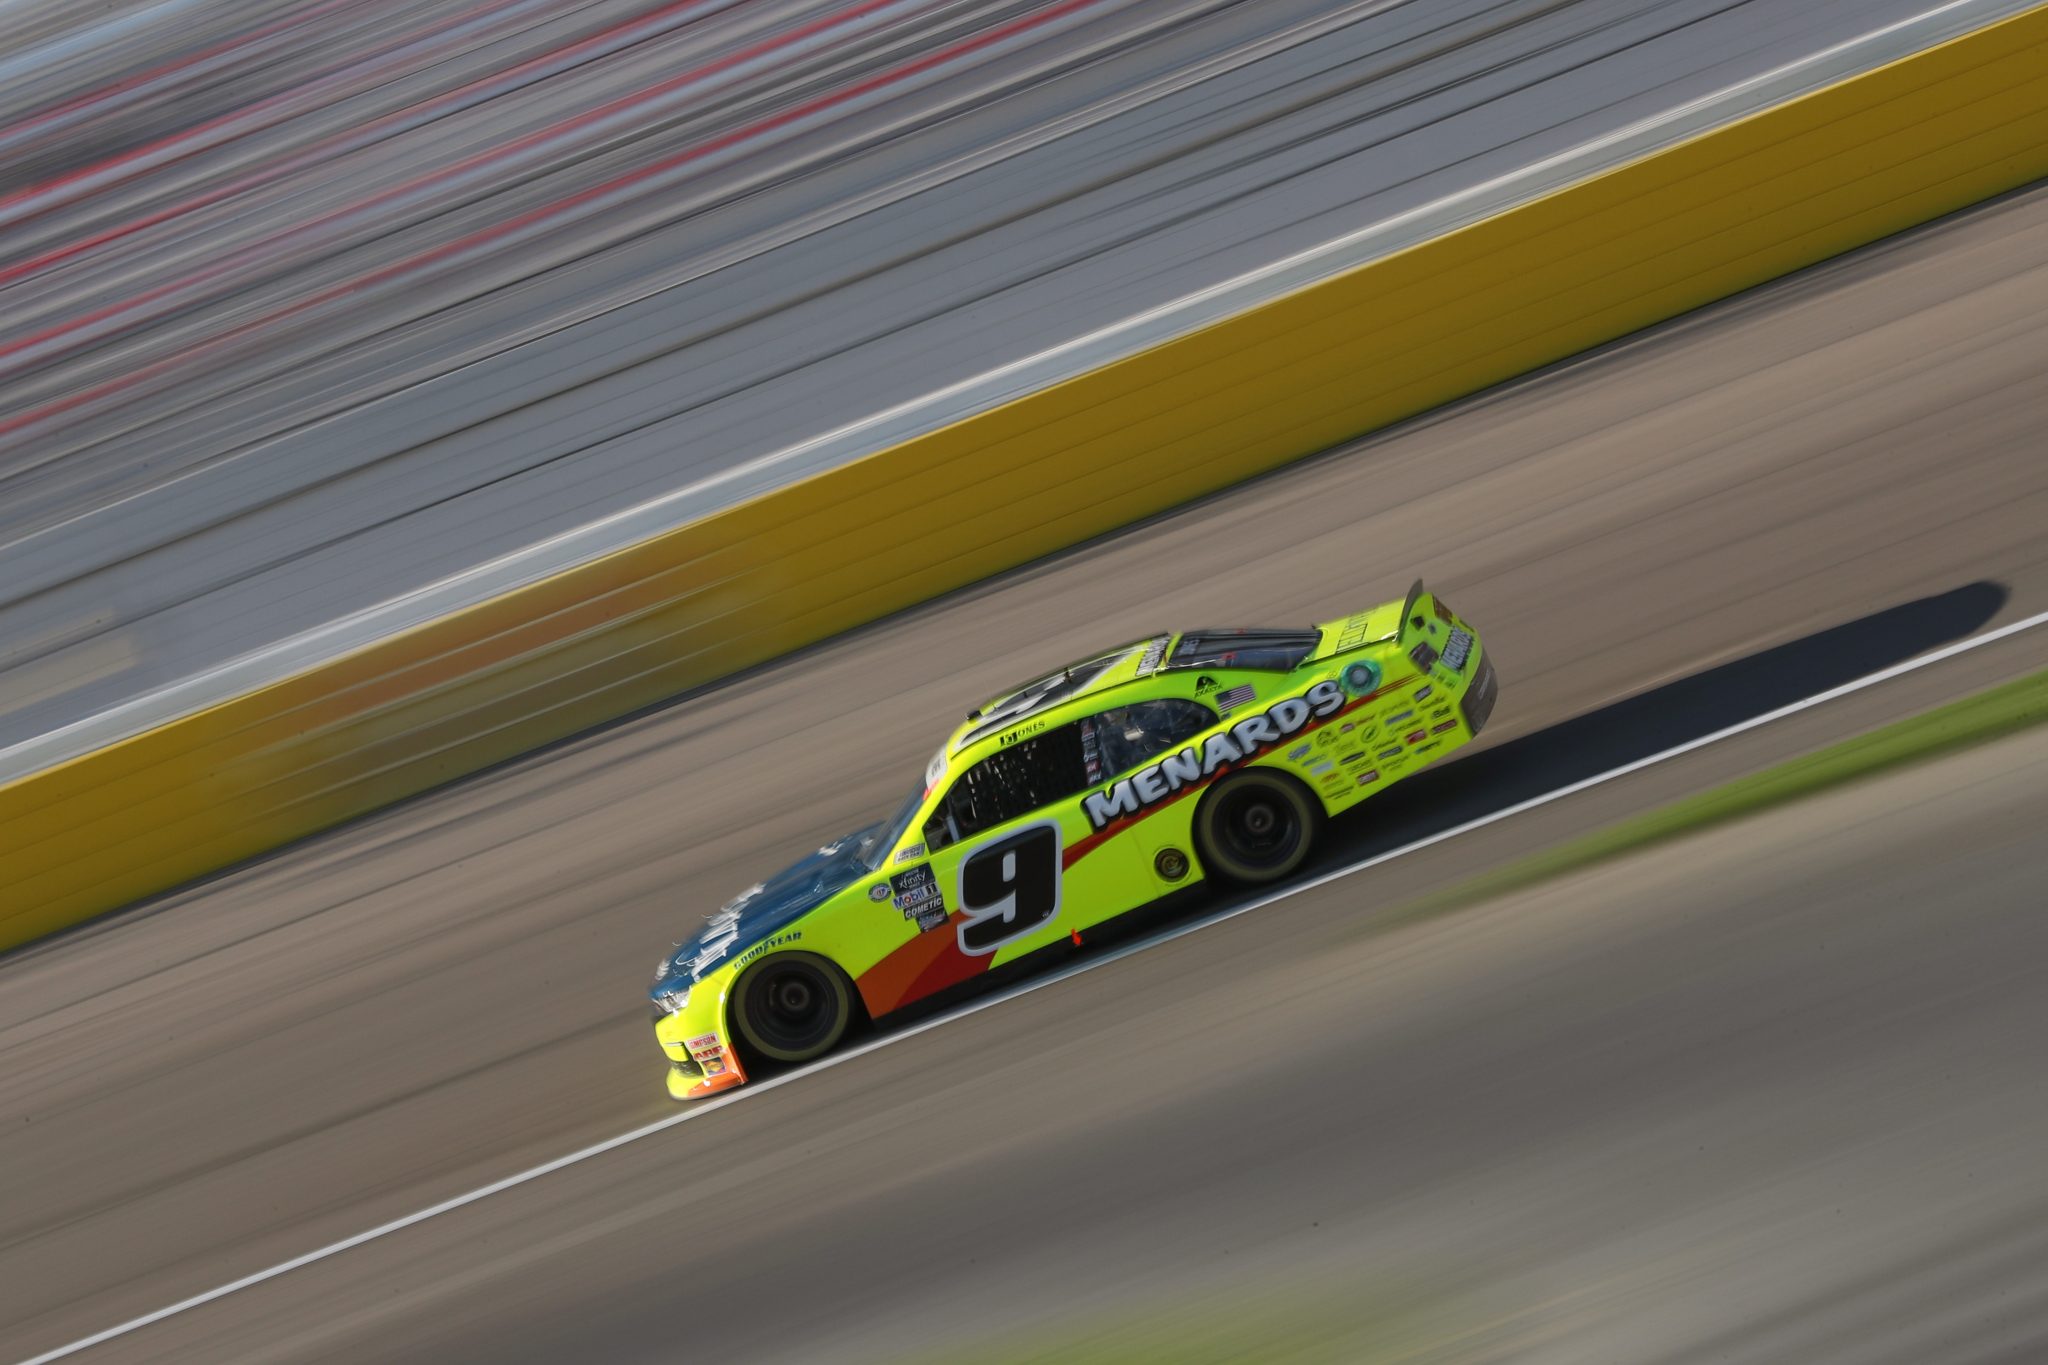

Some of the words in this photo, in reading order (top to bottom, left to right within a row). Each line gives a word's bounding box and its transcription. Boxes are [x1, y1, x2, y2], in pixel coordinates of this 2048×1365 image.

[1083, 680, 1346, 831] MENARDS
[898, 871, 926, 889] xfinity
[958, 818, 1062, 956] 9
[893, 889, 925, 908] Mobil
[905, 898, 942, 918] COMETIC
[734, 932, 802, 970] GOODYEAR
